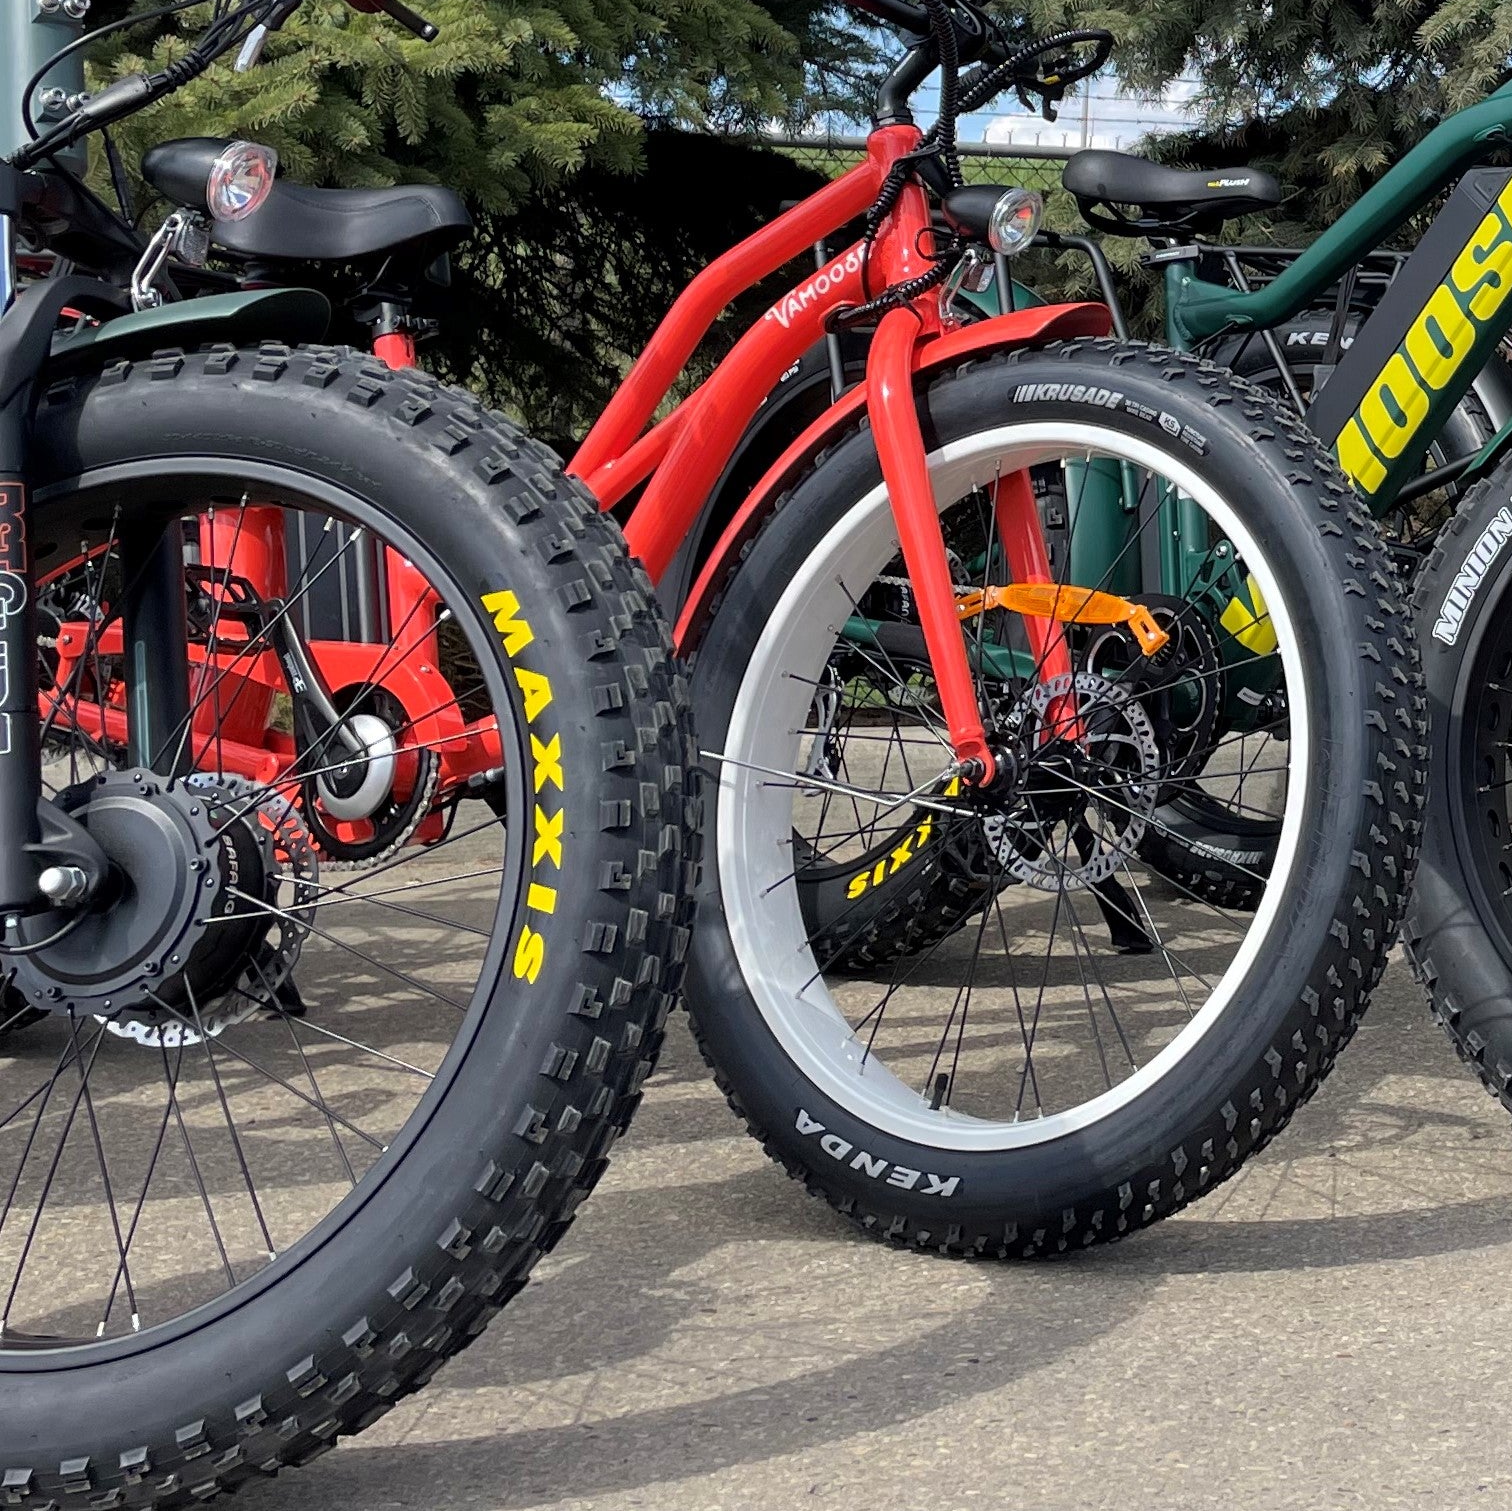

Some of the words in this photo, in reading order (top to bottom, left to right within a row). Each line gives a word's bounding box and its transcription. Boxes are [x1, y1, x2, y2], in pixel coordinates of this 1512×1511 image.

[1030, 383, 1124, 410] KRUSADE
[480, 590, 564, 984] MAXXIS
[795, 1108, 961, 1198] KENDA
